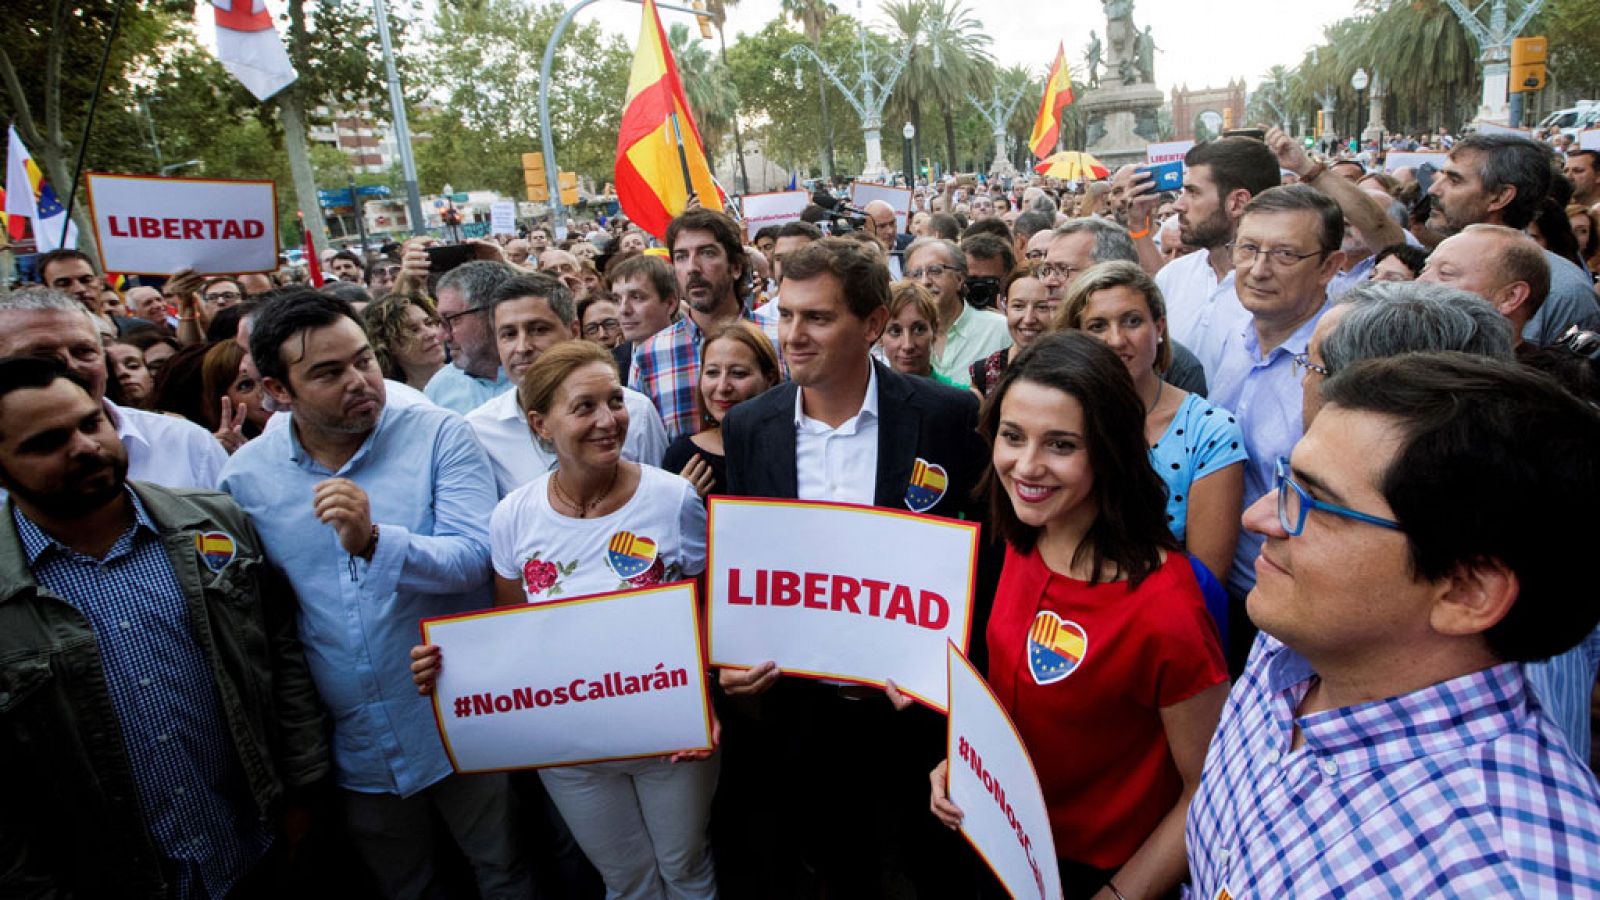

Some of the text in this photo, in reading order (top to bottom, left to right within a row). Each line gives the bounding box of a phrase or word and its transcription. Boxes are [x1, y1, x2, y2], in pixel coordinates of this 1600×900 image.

[1151, 152, 1186, 163] LIBERTA
[108, 215, 265, 240] LIBERTAD
[727, 568, 950, 631] LIBERTAD
[453, 662, 688, 718] #NoNosCallarán
